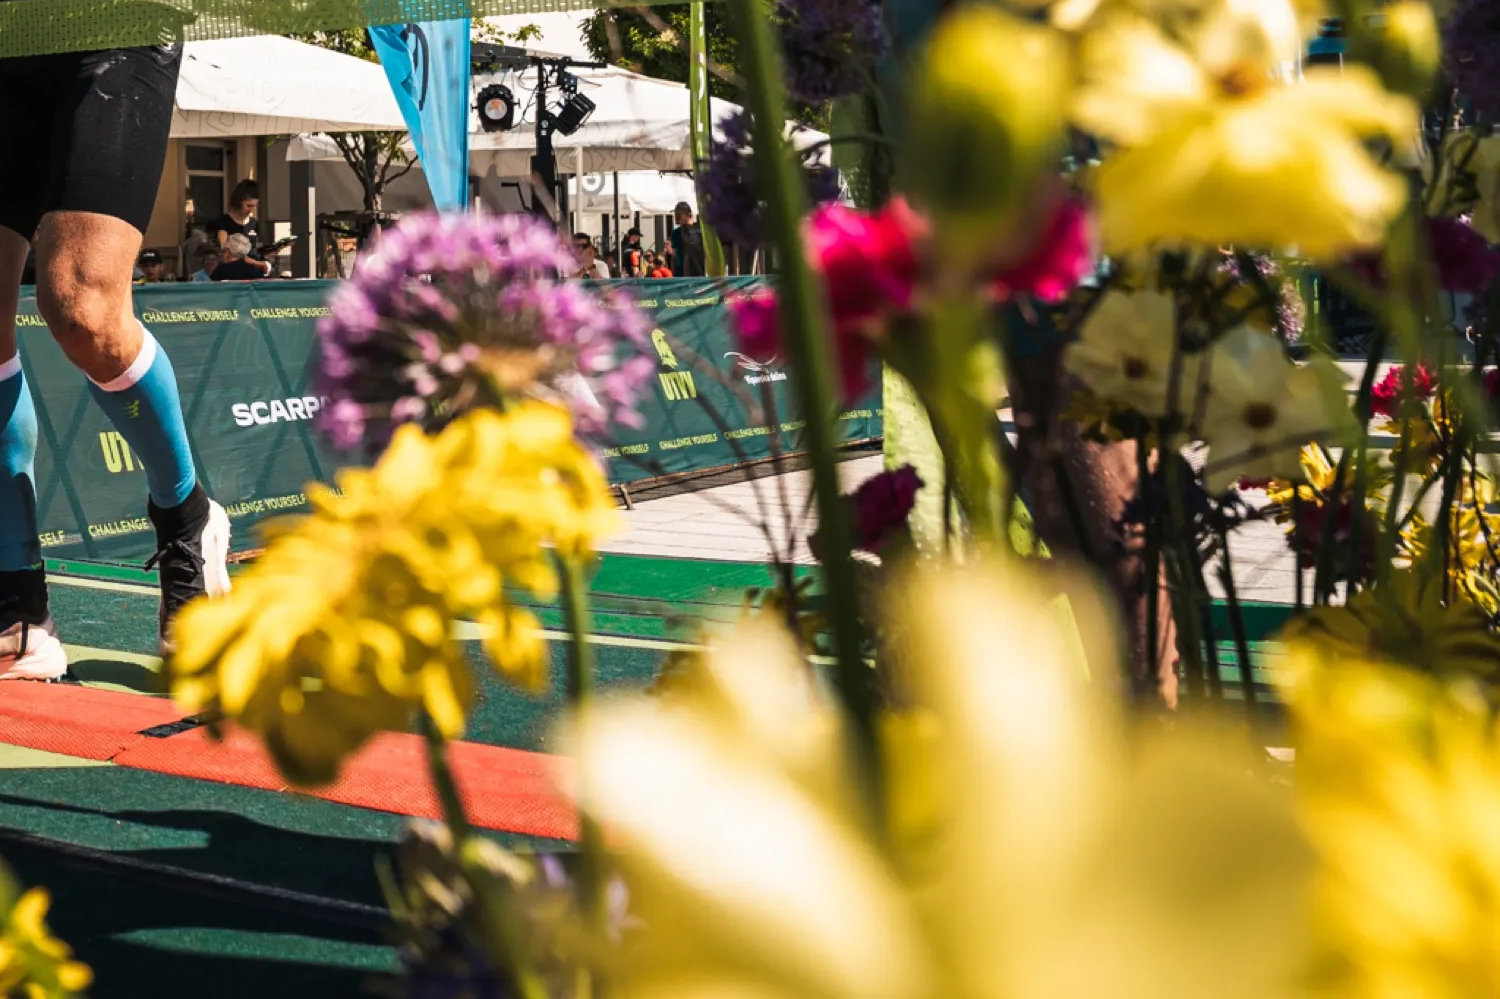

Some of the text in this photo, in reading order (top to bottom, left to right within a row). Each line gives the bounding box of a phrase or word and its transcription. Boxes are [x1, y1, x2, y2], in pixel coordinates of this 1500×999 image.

[142, 308, 239, 323] CHALLENGE YOURSELF
[250, 306, 336, 319] CHALLENGE YOURSEL
[658, 371, 697, 401] UTVV
[231, 396, 330, 427] SCARP
[99, 431, 144, 473] UT
[225, 500, 265, 517] ALLENGE
[265, 493, 306, 510] YOURSELF
[88, 517, 149, 537] CHALLENGE
[38, 530, 65, 547] SELF
